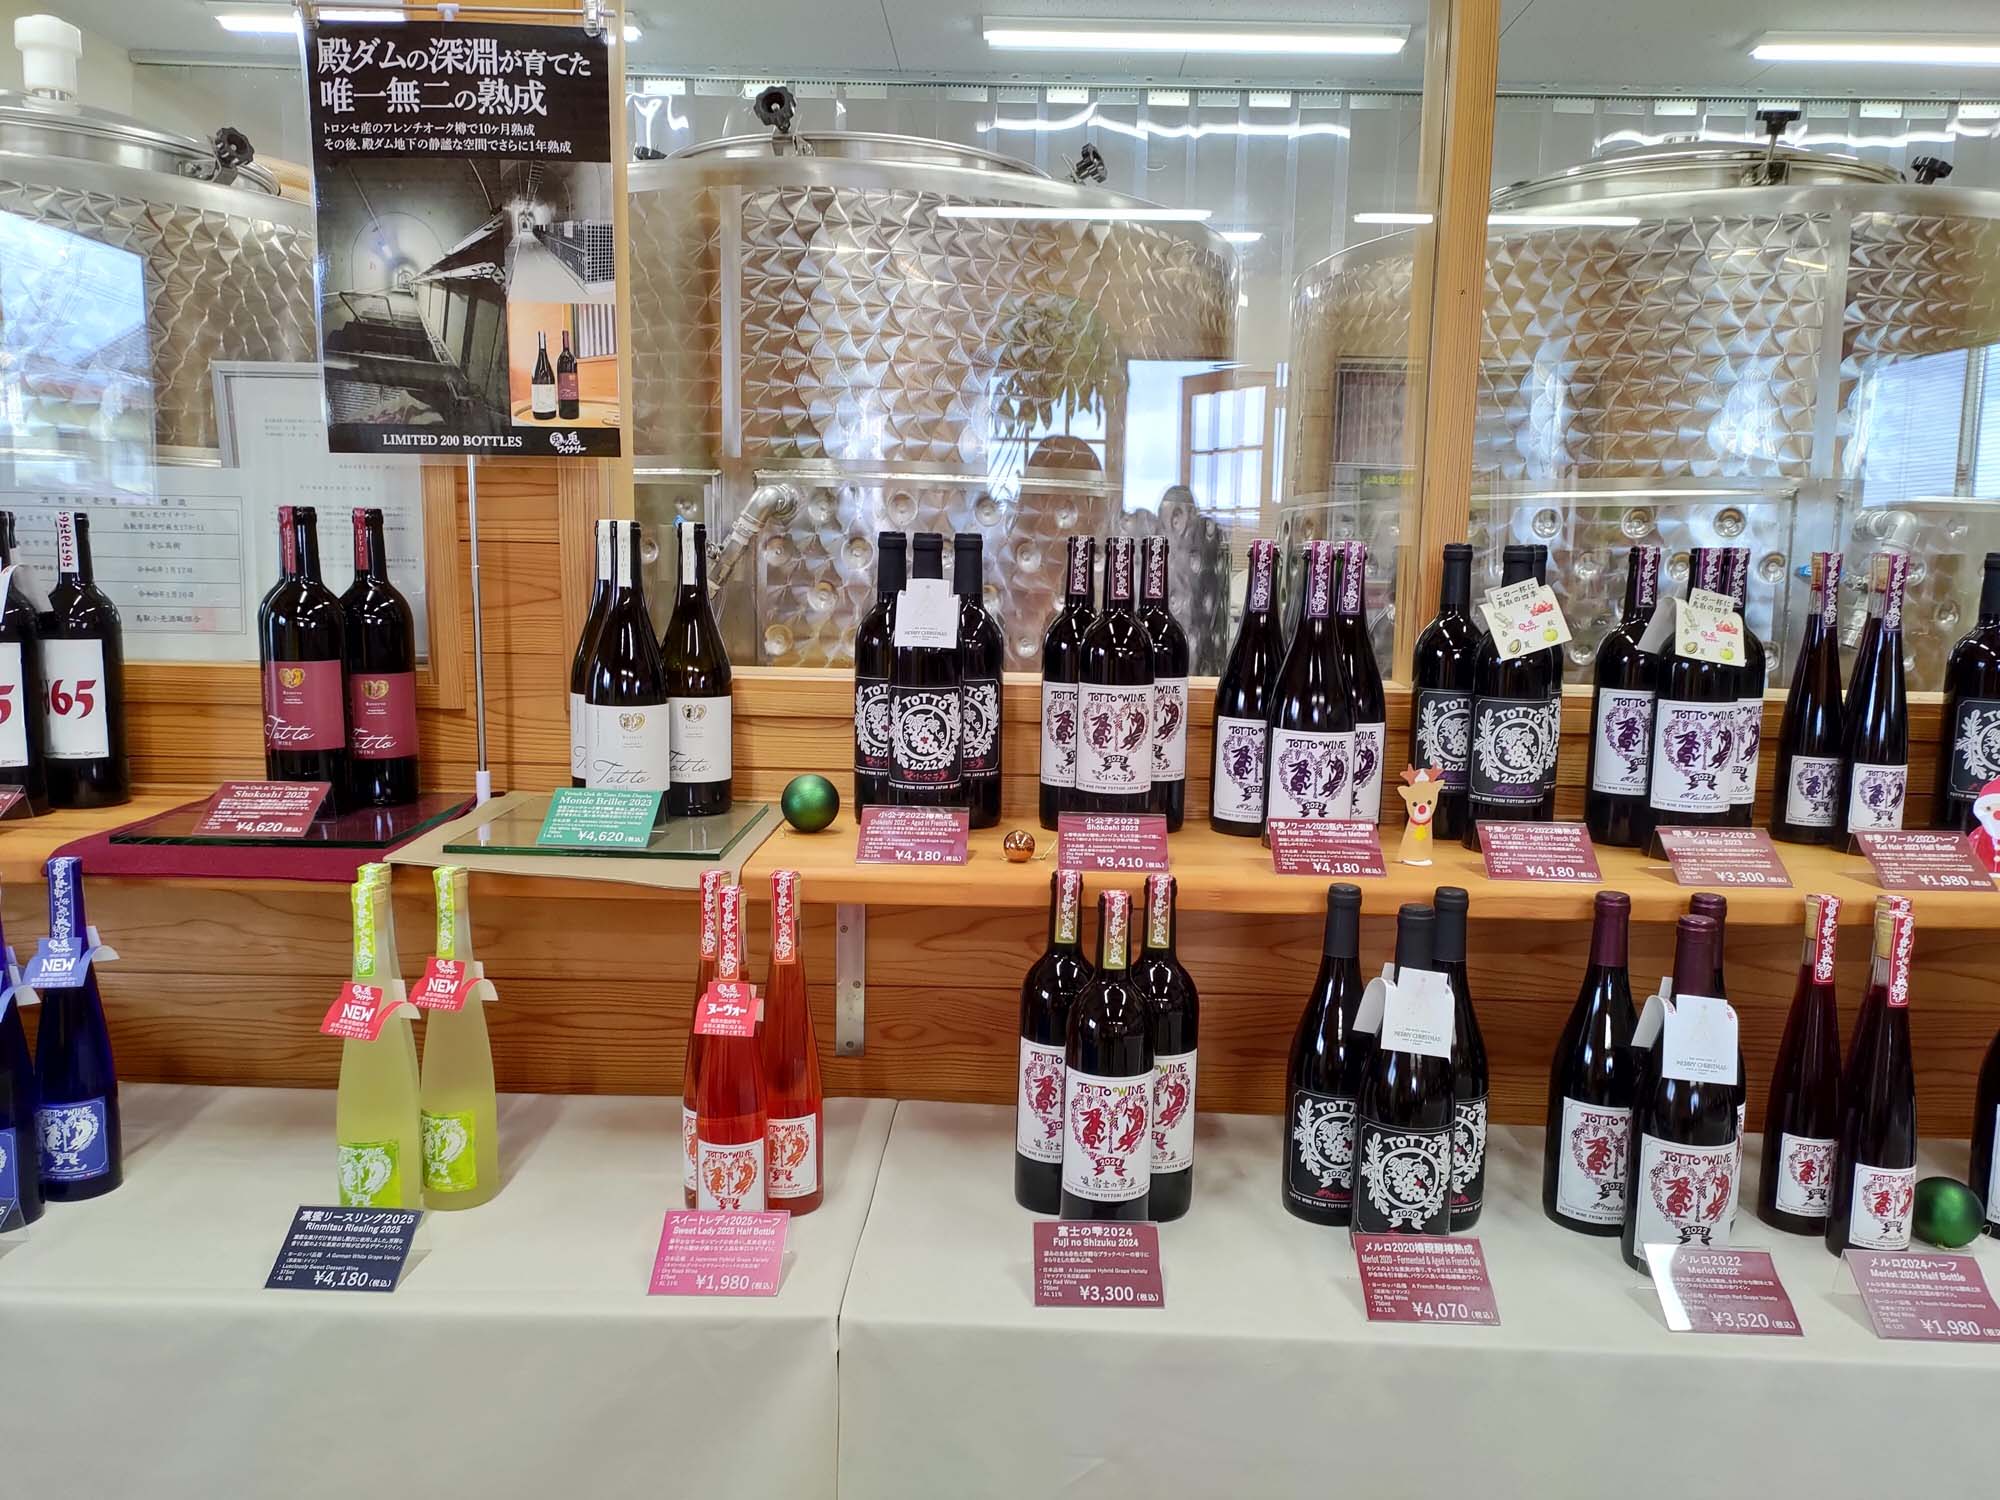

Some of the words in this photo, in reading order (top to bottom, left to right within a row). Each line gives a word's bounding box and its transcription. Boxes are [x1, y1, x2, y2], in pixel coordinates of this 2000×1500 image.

[317, 37, 592, 76] 殿ダムの深淵が育てた
[320, 77, 548, 116] 唯一無二の熟成
[382, 434, 438, 446] LIMITED
[440, 434, 460, 446] 200
[463, 435, 523, 447] BOTTLES
[902, 693, 948, 709] TOTTO
[1088, 692, 1117, 702] TOTTO
[1118, 693, 1147, 702] WINE
[1613, 698, 1646, 707] TOTTO
[1496, 707, 1541, 724] TOTTO
[1672, 710, 1707, 721] TOTTO
[1708, 711, 1734, 720] WINE
[1229, 726, 1257, 736] TOTTO
[1286, 739, 1318, 749] TOTTO
[1319, 740, 1347, 749] WINE
[910, 760, 938, 770] 2022
[1501, 774, 1530, 784] 2022
[560, 796, 594, 805] Monde
[595, 797, 627, 806] Briller
[1085, 817, 1140, 825] 小公子2023
[236, 822, 282, 832] ¥4,620
[578, 831, 624, 841] ¥4,620
[896, 850, 941, 861] ¥4,180
[1097, 857, 1144, 868] ¥3,410
[1312, 862, 1360, 874] ¥4,180
[1526, 865, 1575, 877] ¥4,180
[1715, 872, 1765, 882] ¥3,300
[1918, 875, 1969, 886] ¥1,980
[41, 957, 76, 972] NEW
[427, 977, 459, 994] NEW
[341, 1003, 375, 1022] NEW
[707, 1003, 747, 1016] ヌーヴォー
[1031, 1052, 1063, 1063] TOTTO
[1155, 1063, 1187, 1075] WINE
[1077, 1082, 1111, 1096] TOTTO
[1113, 1083, 1146, 1096] WINE
[1582, 1113, 1619, 1126] TOTTO
[1384, 1135, 1438, 1154] TOTTO
[705, 1150, 729, 1159] TOTTO
[732, 1149, 753, 1159] WINE
[1661, 1151, 1700, 1166] TOTTO
[1702, 1152, 1733, 1165] WINE
[1099, 1158, 1122, 1166] 2024
[1870, 1174, 1897, 1183] TOTTO
[1396, 1210, 1419, 1218] 2020
[670, 1215, 782, 1226] スイートレディ2025ハーフ
[305, 1222, 343, 1231] Rinmitsu
[345, 1224, 378, 1234] Riesling
[380, 1225, 401, 1233] 2025
[1058, 1226, 1133, 1237] 富士の雫2024
[1684, 1227, 1708, 1235] 2022
[1053, 1238, 1069, 1247] Fuji
[1083, 1238, 1116, 1246] Shizuku
[1118, 1238, 1138, 1246] 2024
[1680, 1255, 1742, 1266] メルロ2022
[1870, 1258, 1957, 1271] メルロ2024ハーフ
[1687, 1266, 1717, 1275] Merlot
[1718, 1267, 1740, 1275] 2022
[1870, 1269, 1898, 1279] Merlot
[1900, 1270, 1919, 1280] 2024
[1920, 1271, 1939, 1281] Half
[1940, 1272, 1966, 1282] Bottle
[313, 1270, 368, 1288] ¥4,180
[696, 1274, 749, 1290] ¥1,980
[1080, 1286, 1134, 1302] ¥3,300
[1412, 1302, 1468, 1319] ¥4,070
[1711, 1312, 1769, 1329] ¥3,520
[1920, 1319, 1980, 1336] ¥1,980
